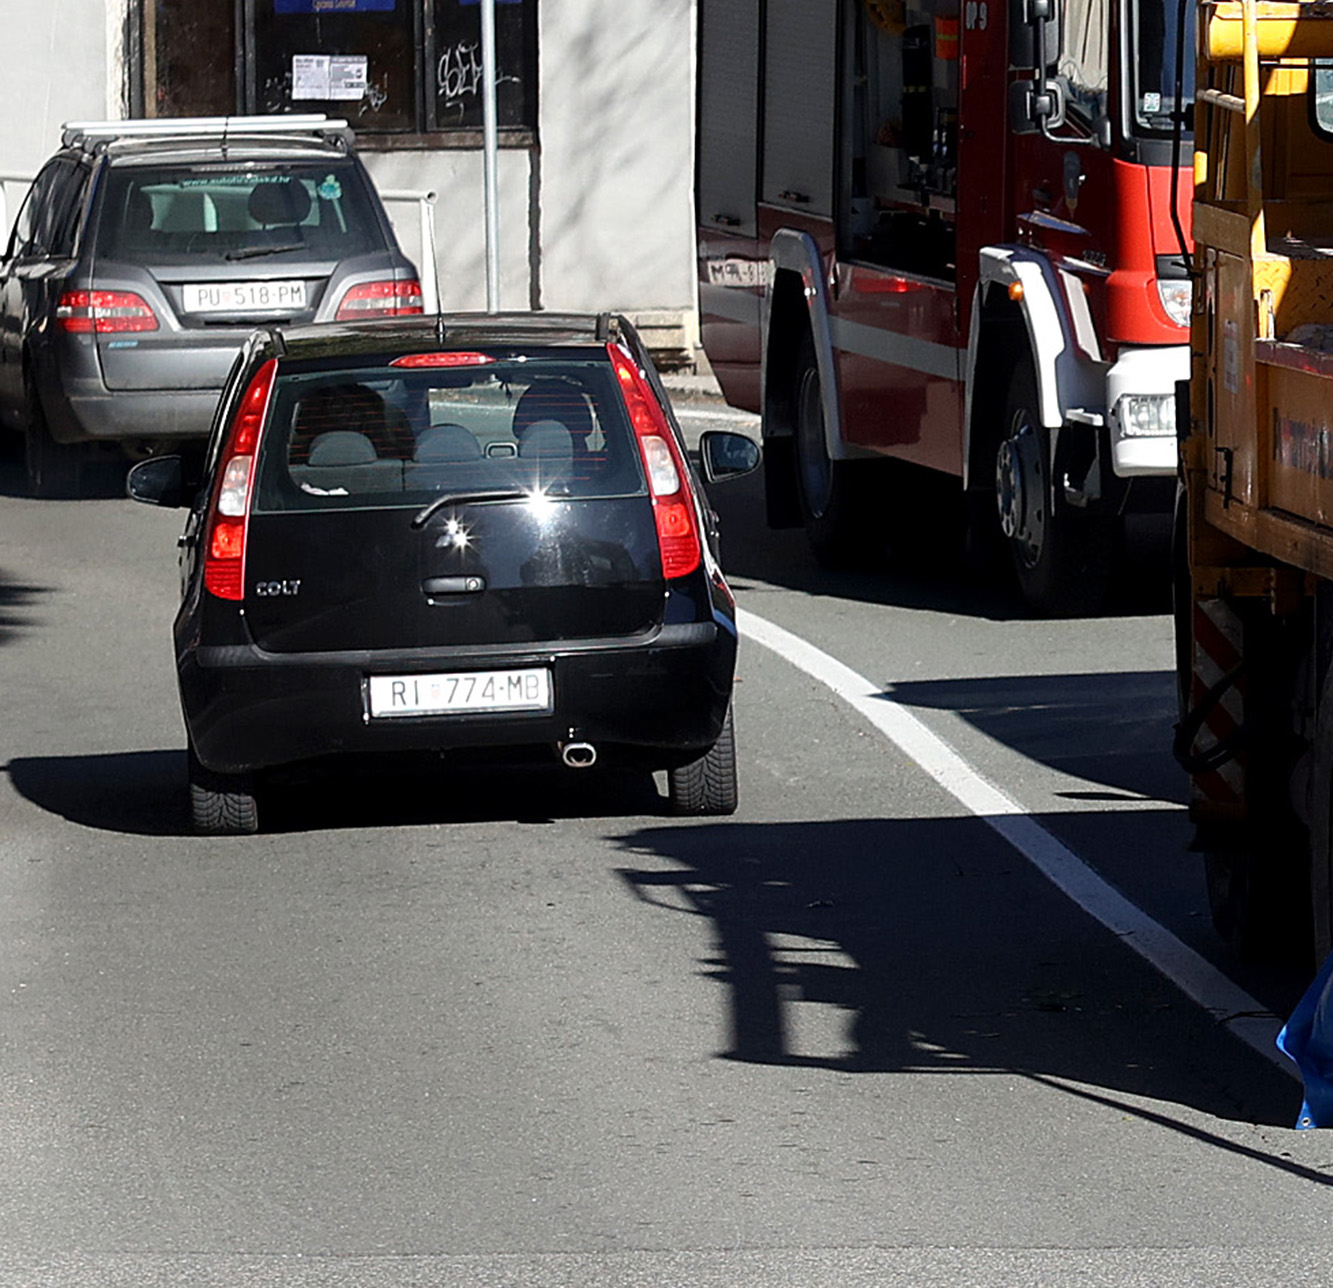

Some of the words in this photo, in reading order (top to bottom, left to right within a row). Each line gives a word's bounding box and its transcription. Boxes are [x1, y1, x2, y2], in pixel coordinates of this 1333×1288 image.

[199, 289, 221, 306] PU
[255, 579, 301, 597] COLT
[391, 680, 419, 706] RI
